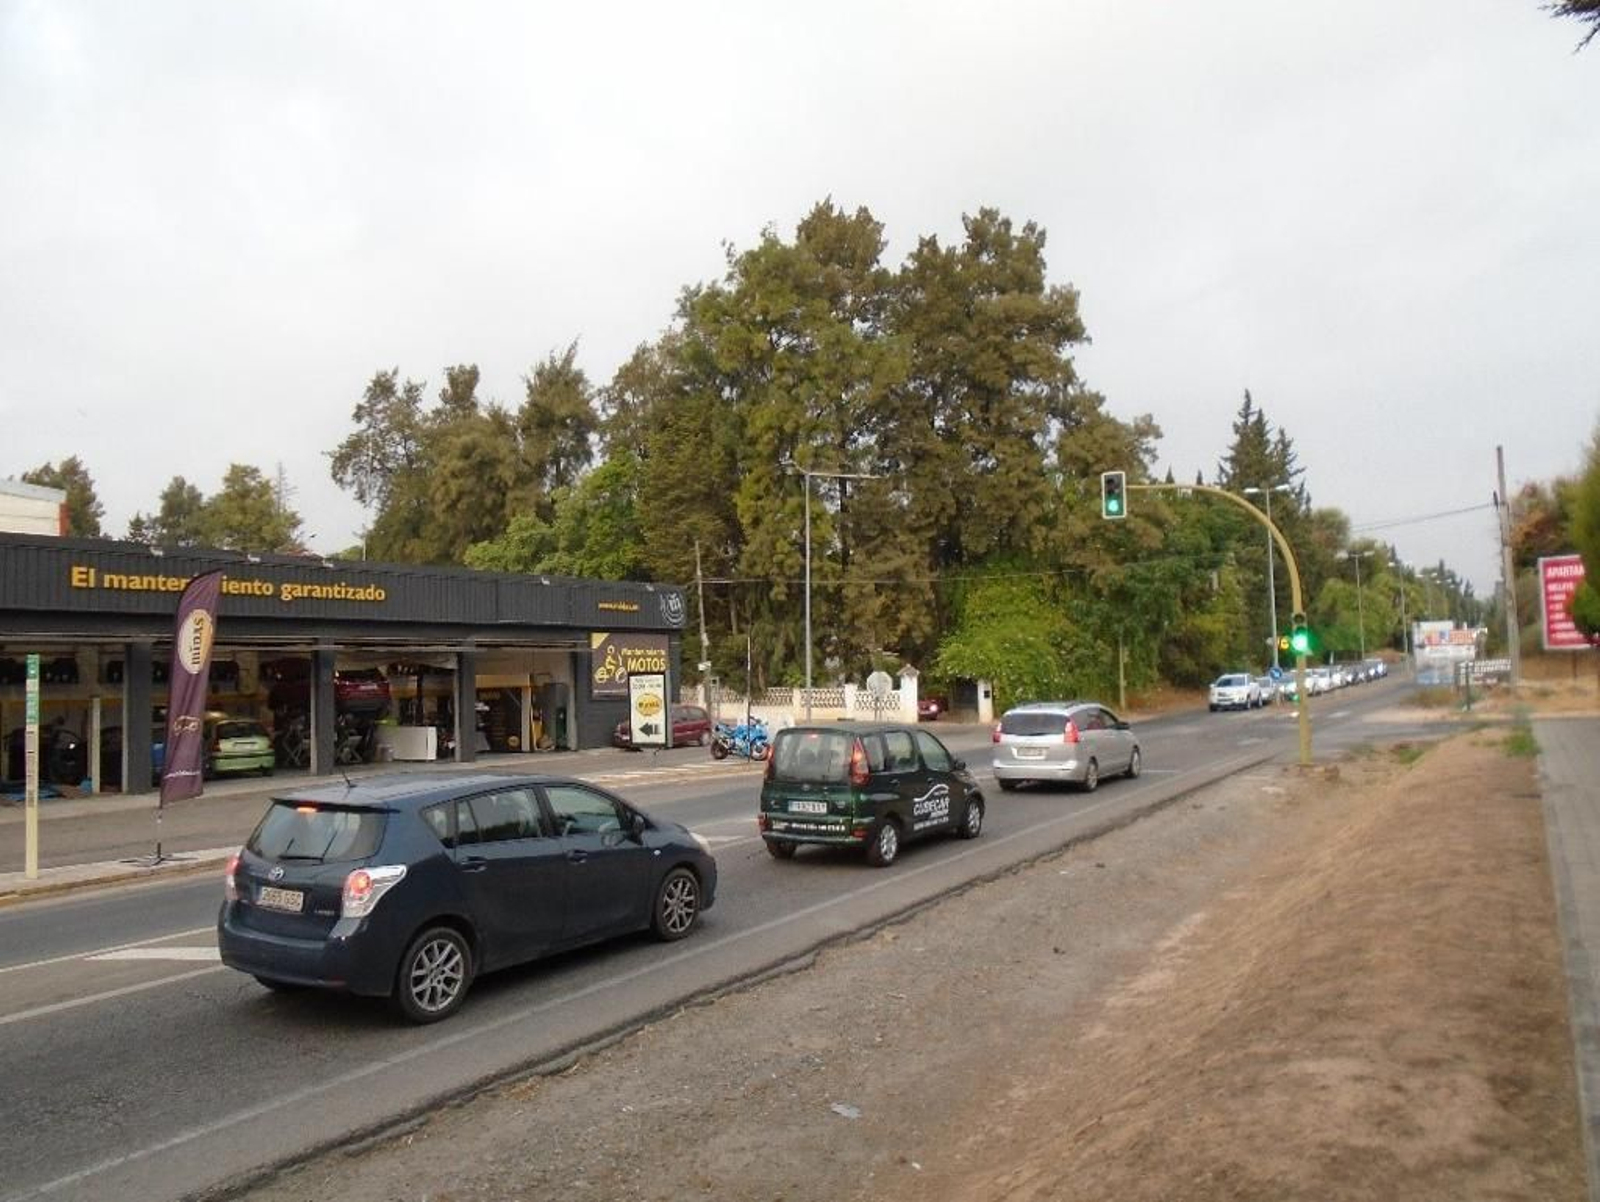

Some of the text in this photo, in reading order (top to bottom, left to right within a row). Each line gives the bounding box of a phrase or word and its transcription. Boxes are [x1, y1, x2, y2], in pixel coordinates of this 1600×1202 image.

[71, 566, 386, 601] El manteniento garantizado
[627, 657, 666, 672] MOTOS
